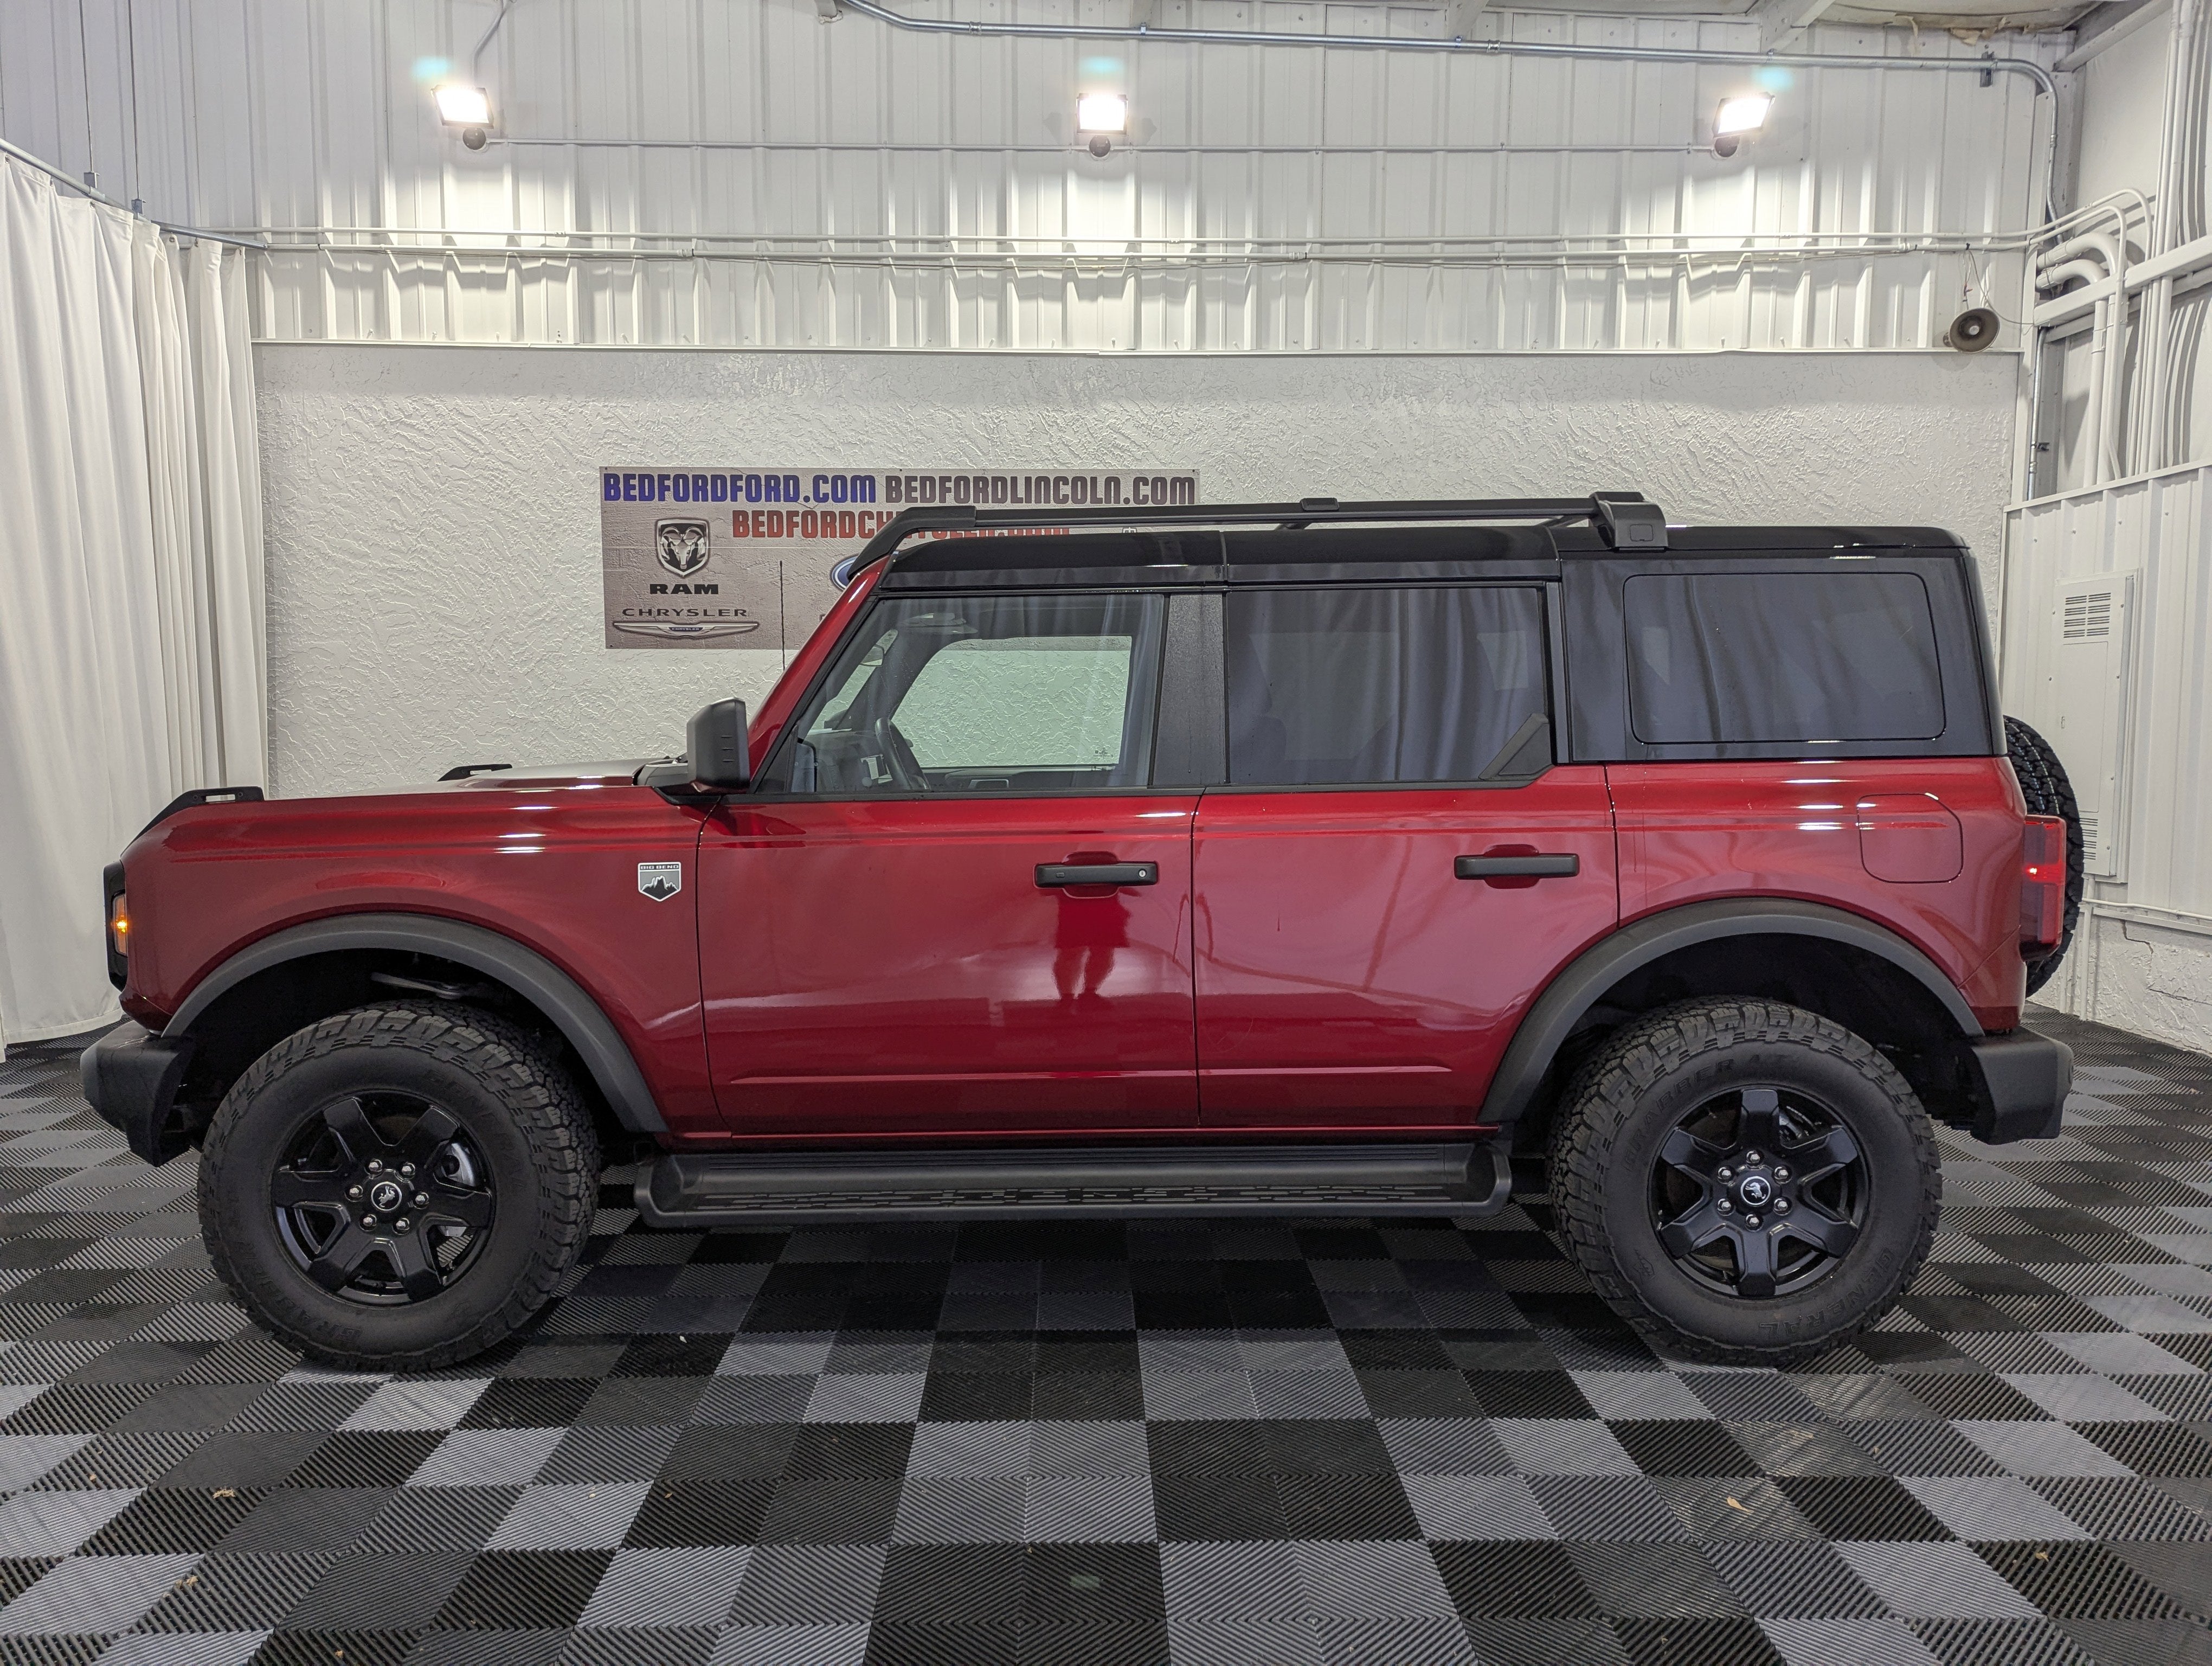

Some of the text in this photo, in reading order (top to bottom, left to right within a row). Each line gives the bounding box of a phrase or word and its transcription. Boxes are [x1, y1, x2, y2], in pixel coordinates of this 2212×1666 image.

[603, 473, 1195, 505] BEDFORDFORD.COM BEDFORDLINCOLN.COM
[650, 584, 719, 594] RAM
[622, 608, 748, 617] CHRYSLER
